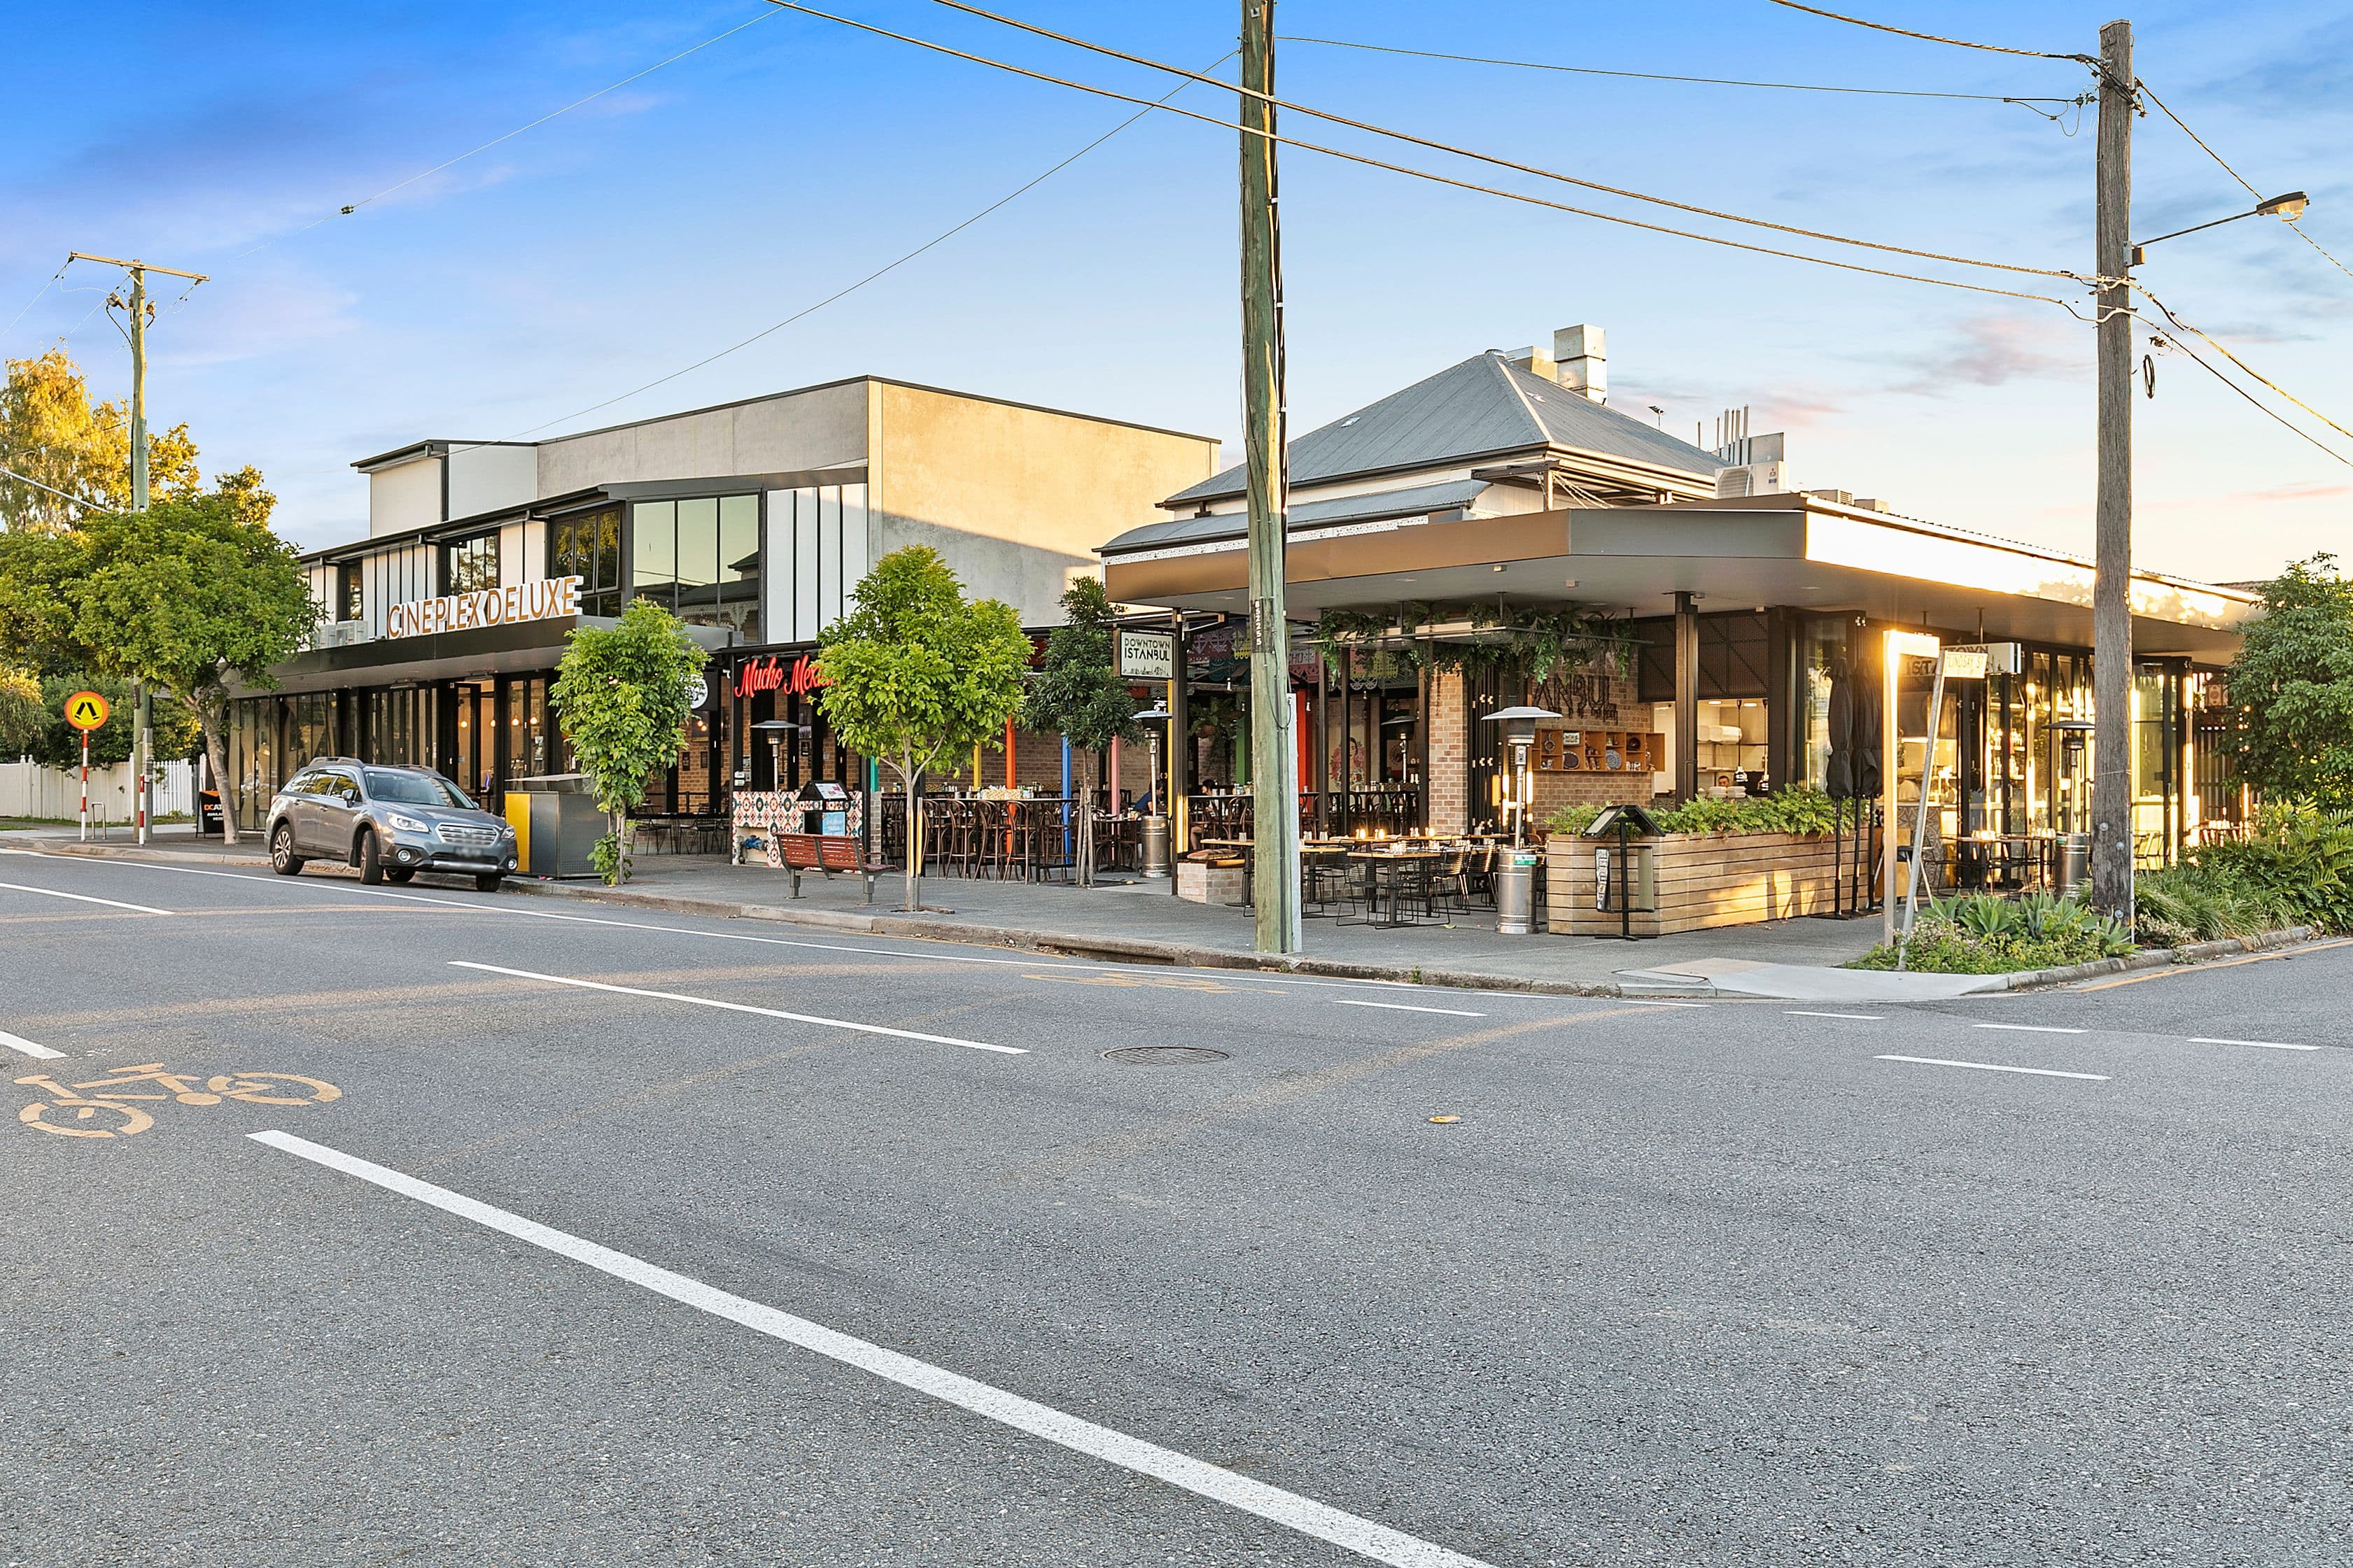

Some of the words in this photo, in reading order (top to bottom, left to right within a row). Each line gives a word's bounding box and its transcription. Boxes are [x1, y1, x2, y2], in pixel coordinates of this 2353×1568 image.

[387, 591, 482, 638] CINEPLEX
[487, 577, 577, 625] DELUXE
[1124, 637, 1171, 649] DOWNTOWN
[1124, 647, 1170, 661] ISTANBUL
[733, 656, 785, 698] Mucho
